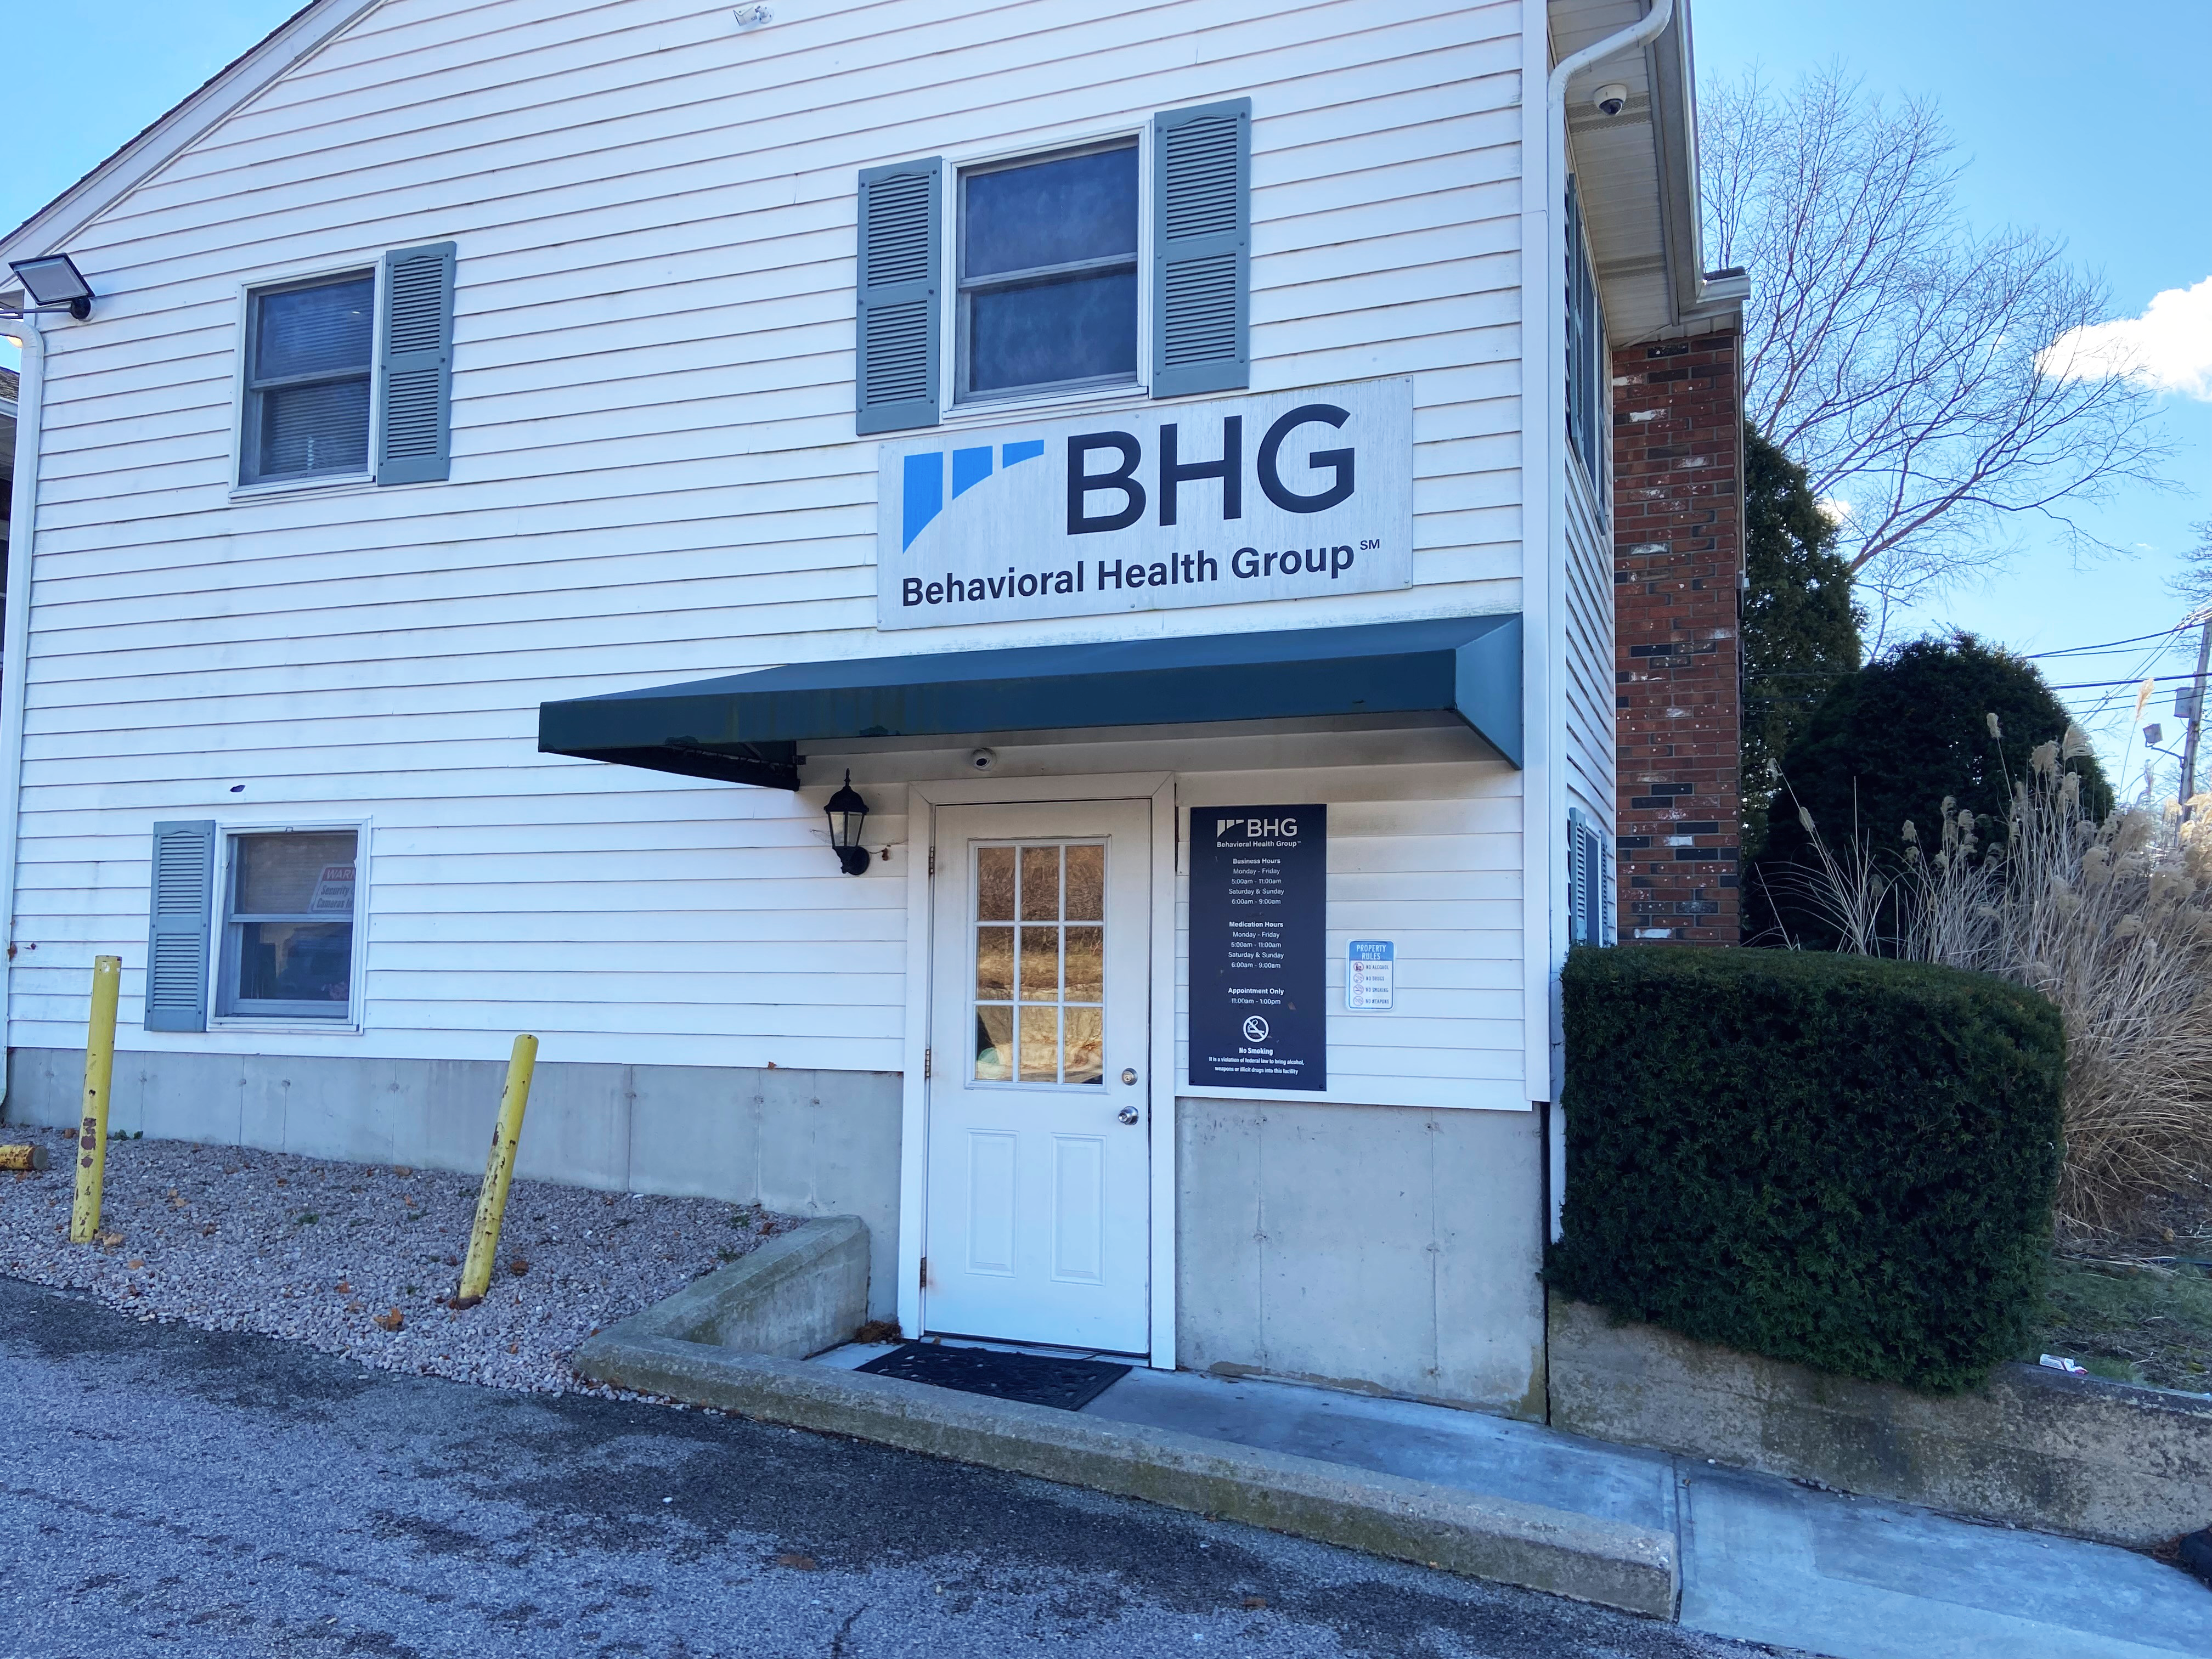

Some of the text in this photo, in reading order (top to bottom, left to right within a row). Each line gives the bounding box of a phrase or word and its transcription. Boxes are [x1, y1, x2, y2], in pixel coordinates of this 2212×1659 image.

[1066, 403, 1356, 536] BHG
[902, 561, 1085, 607] Behavioral
[1097, 550, 1218, 590] Health
[1231, 543, 1354, 580] Group
[1247, 818, 1297, 837] BHG
[321, 884, 349, 896] Security
[317, 898, 345, 908] Cameras
[1356, 944, 1386, 952] PROPERTY
[1248, 1047, 1273, 1056] Smoking
